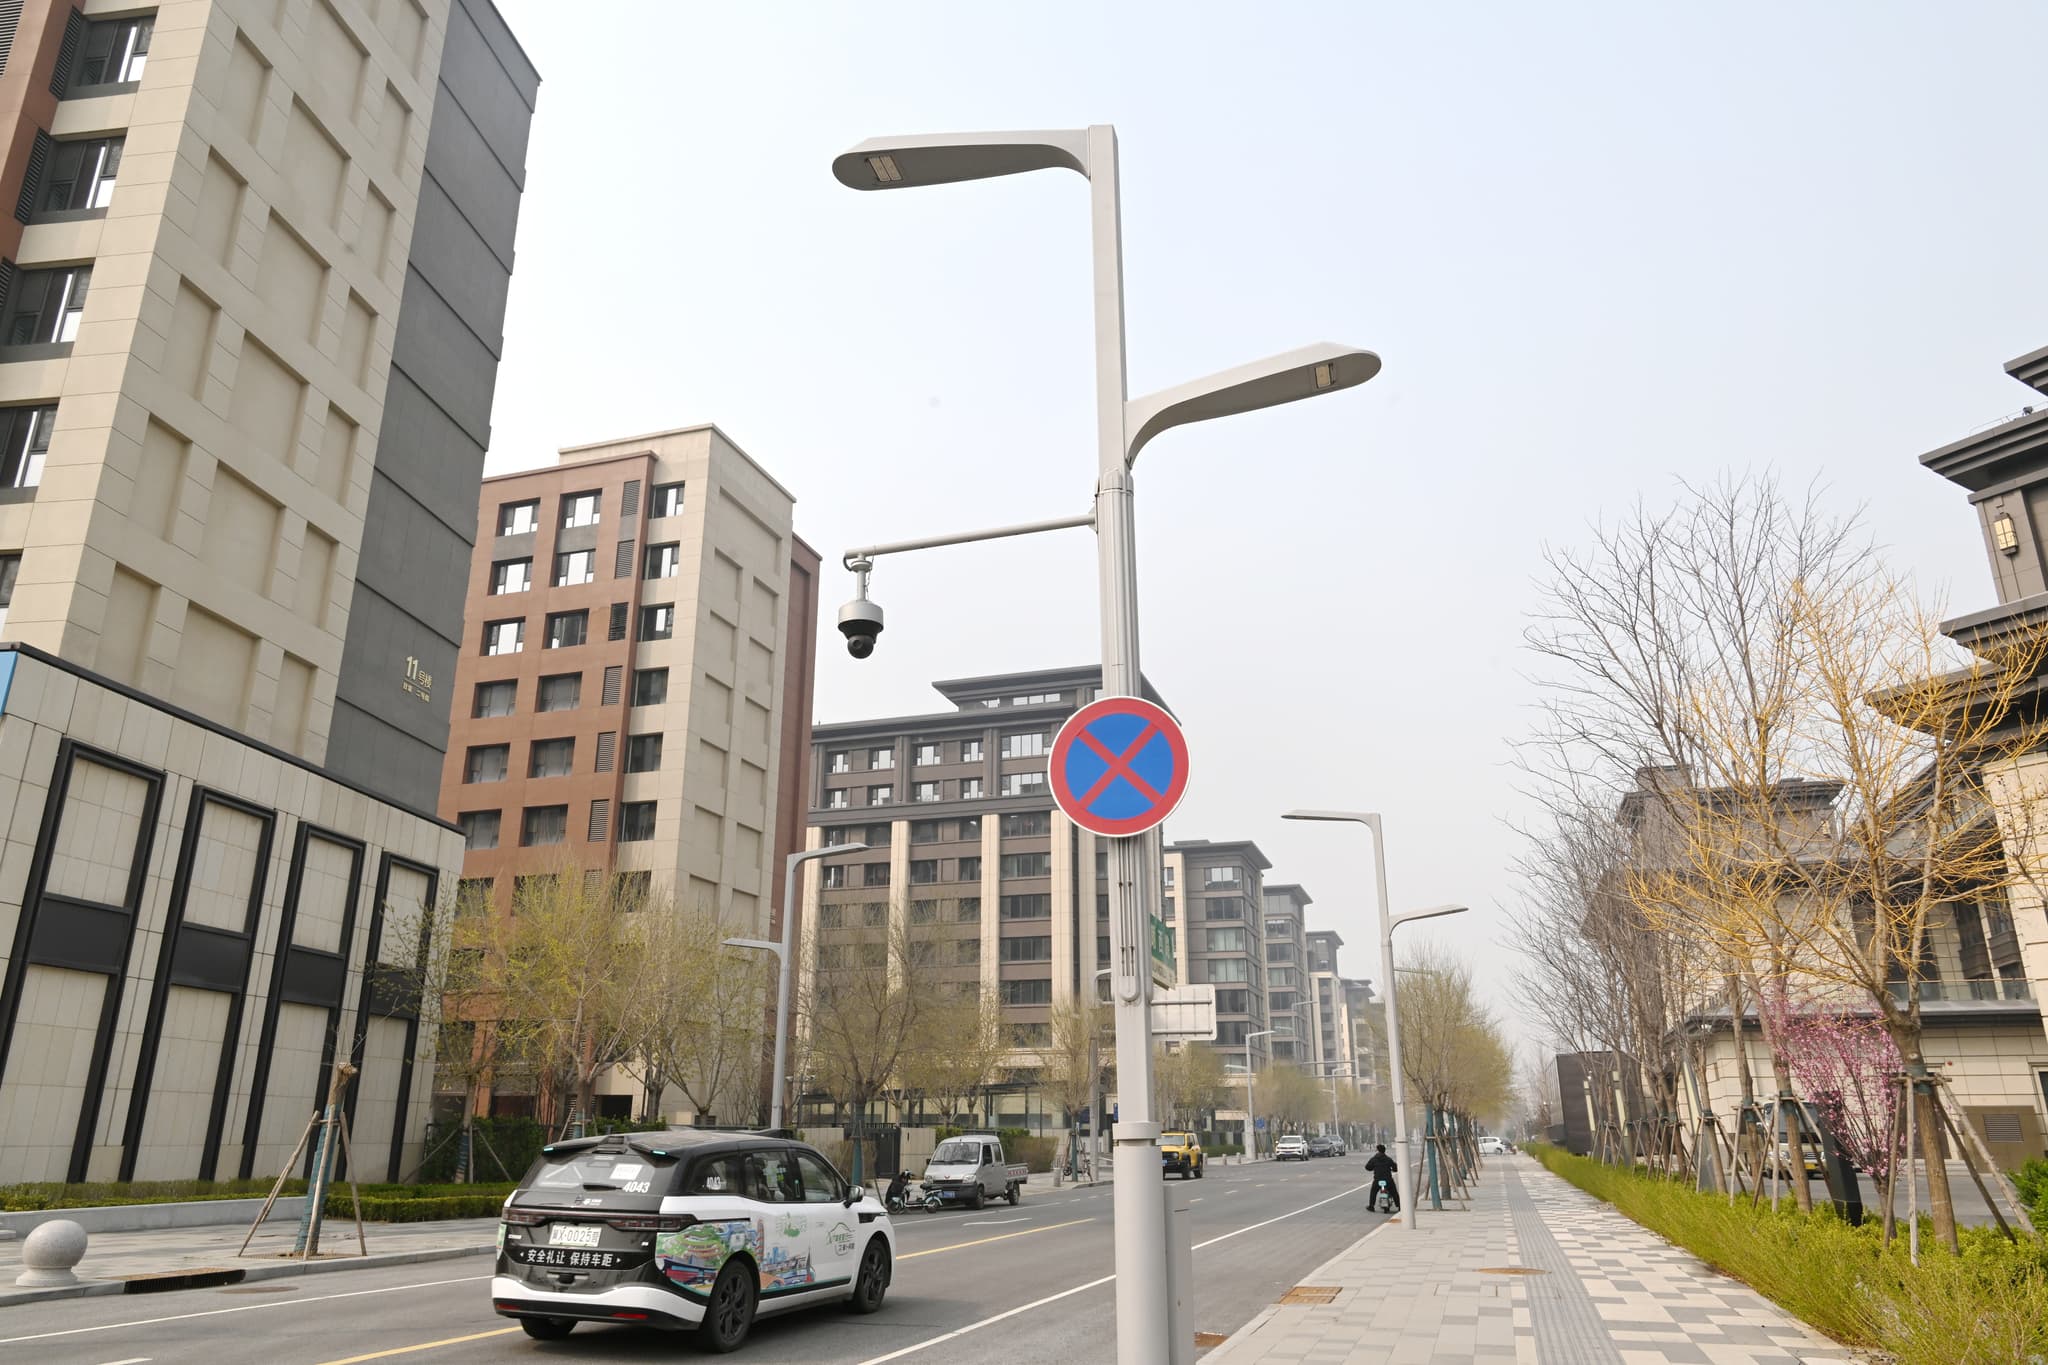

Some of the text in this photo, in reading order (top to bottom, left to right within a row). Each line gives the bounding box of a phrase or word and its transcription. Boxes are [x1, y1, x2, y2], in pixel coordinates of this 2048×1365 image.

[406, 655, 433, 689] 11号楼
[622, 1181, 651, 1193] 4043
[527, 1249, 614, 1267] 安全礼让 保持车距
